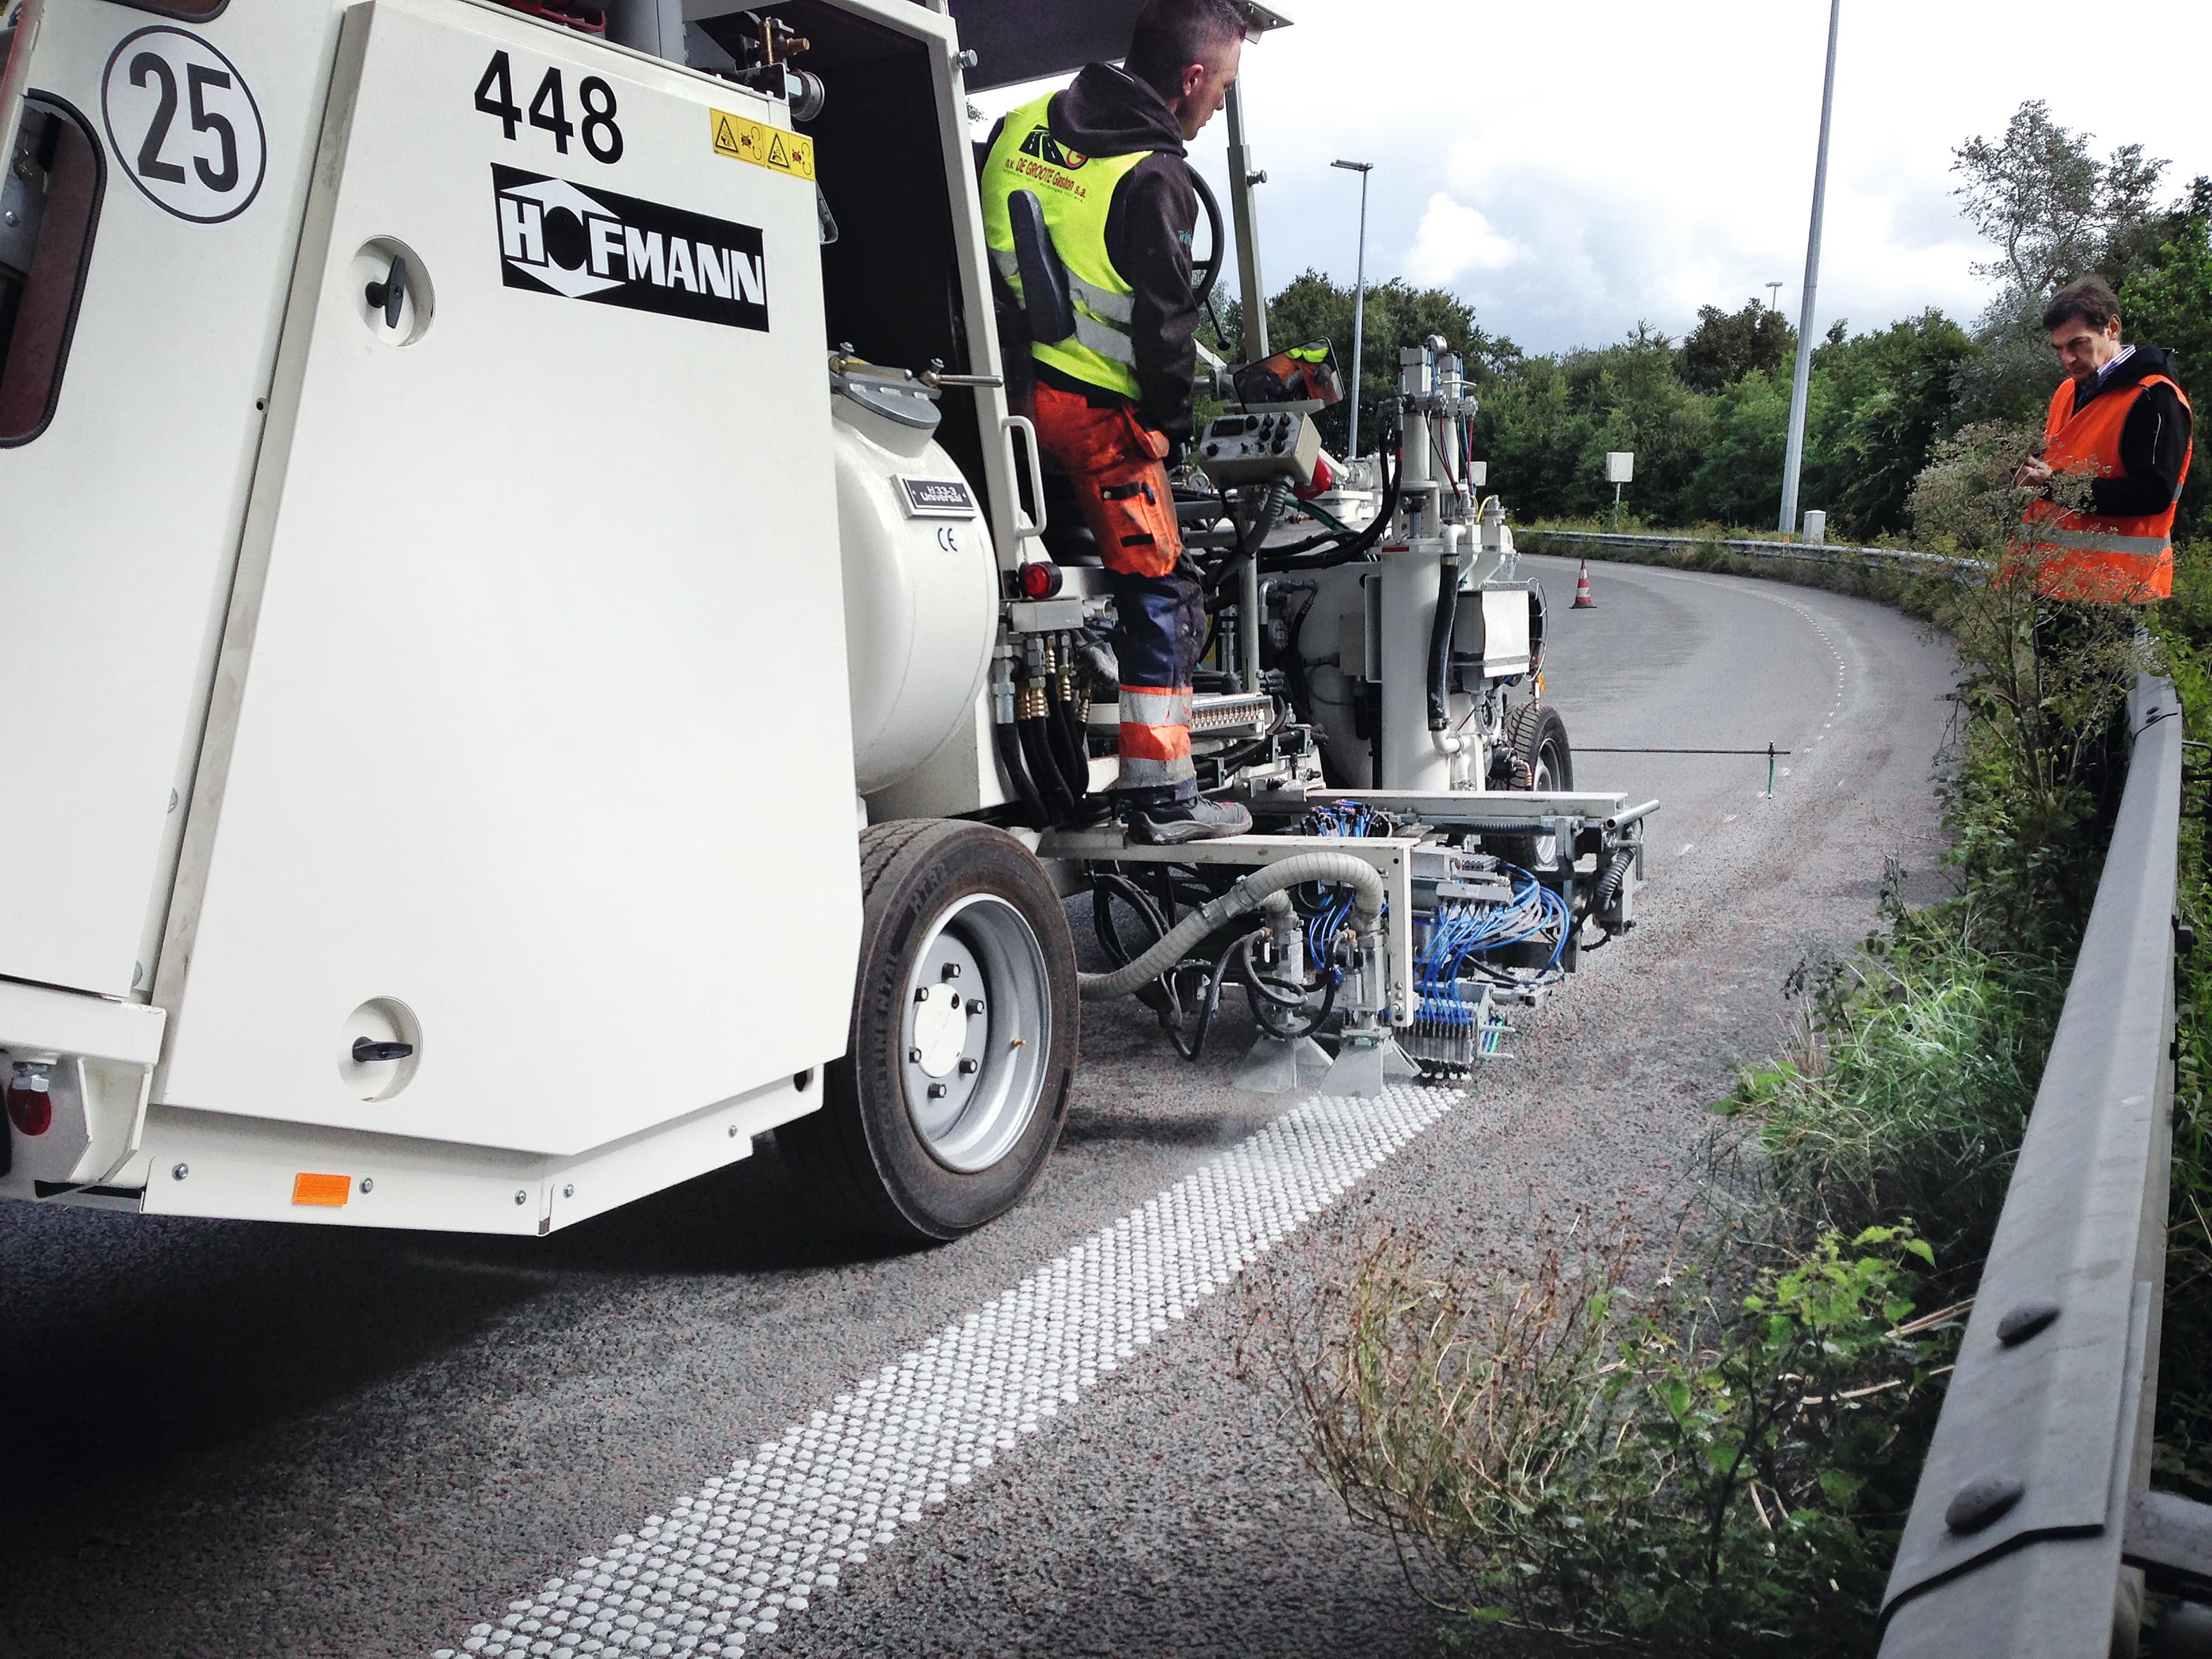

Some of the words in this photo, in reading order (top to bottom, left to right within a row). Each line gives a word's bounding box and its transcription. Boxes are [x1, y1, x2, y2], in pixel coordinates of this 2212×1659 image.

[129, 51, 239, 193] 25
[474, 49, 624, 165] 448
[1015, 157, 1027, 173] DE
[1025, 162, 1055, 183] GROOTE
[1052, 171, 1074, 191] Gaston
[499, 195, 765, 306] HOFMANN
[920, 492, 963, 502] Universal
